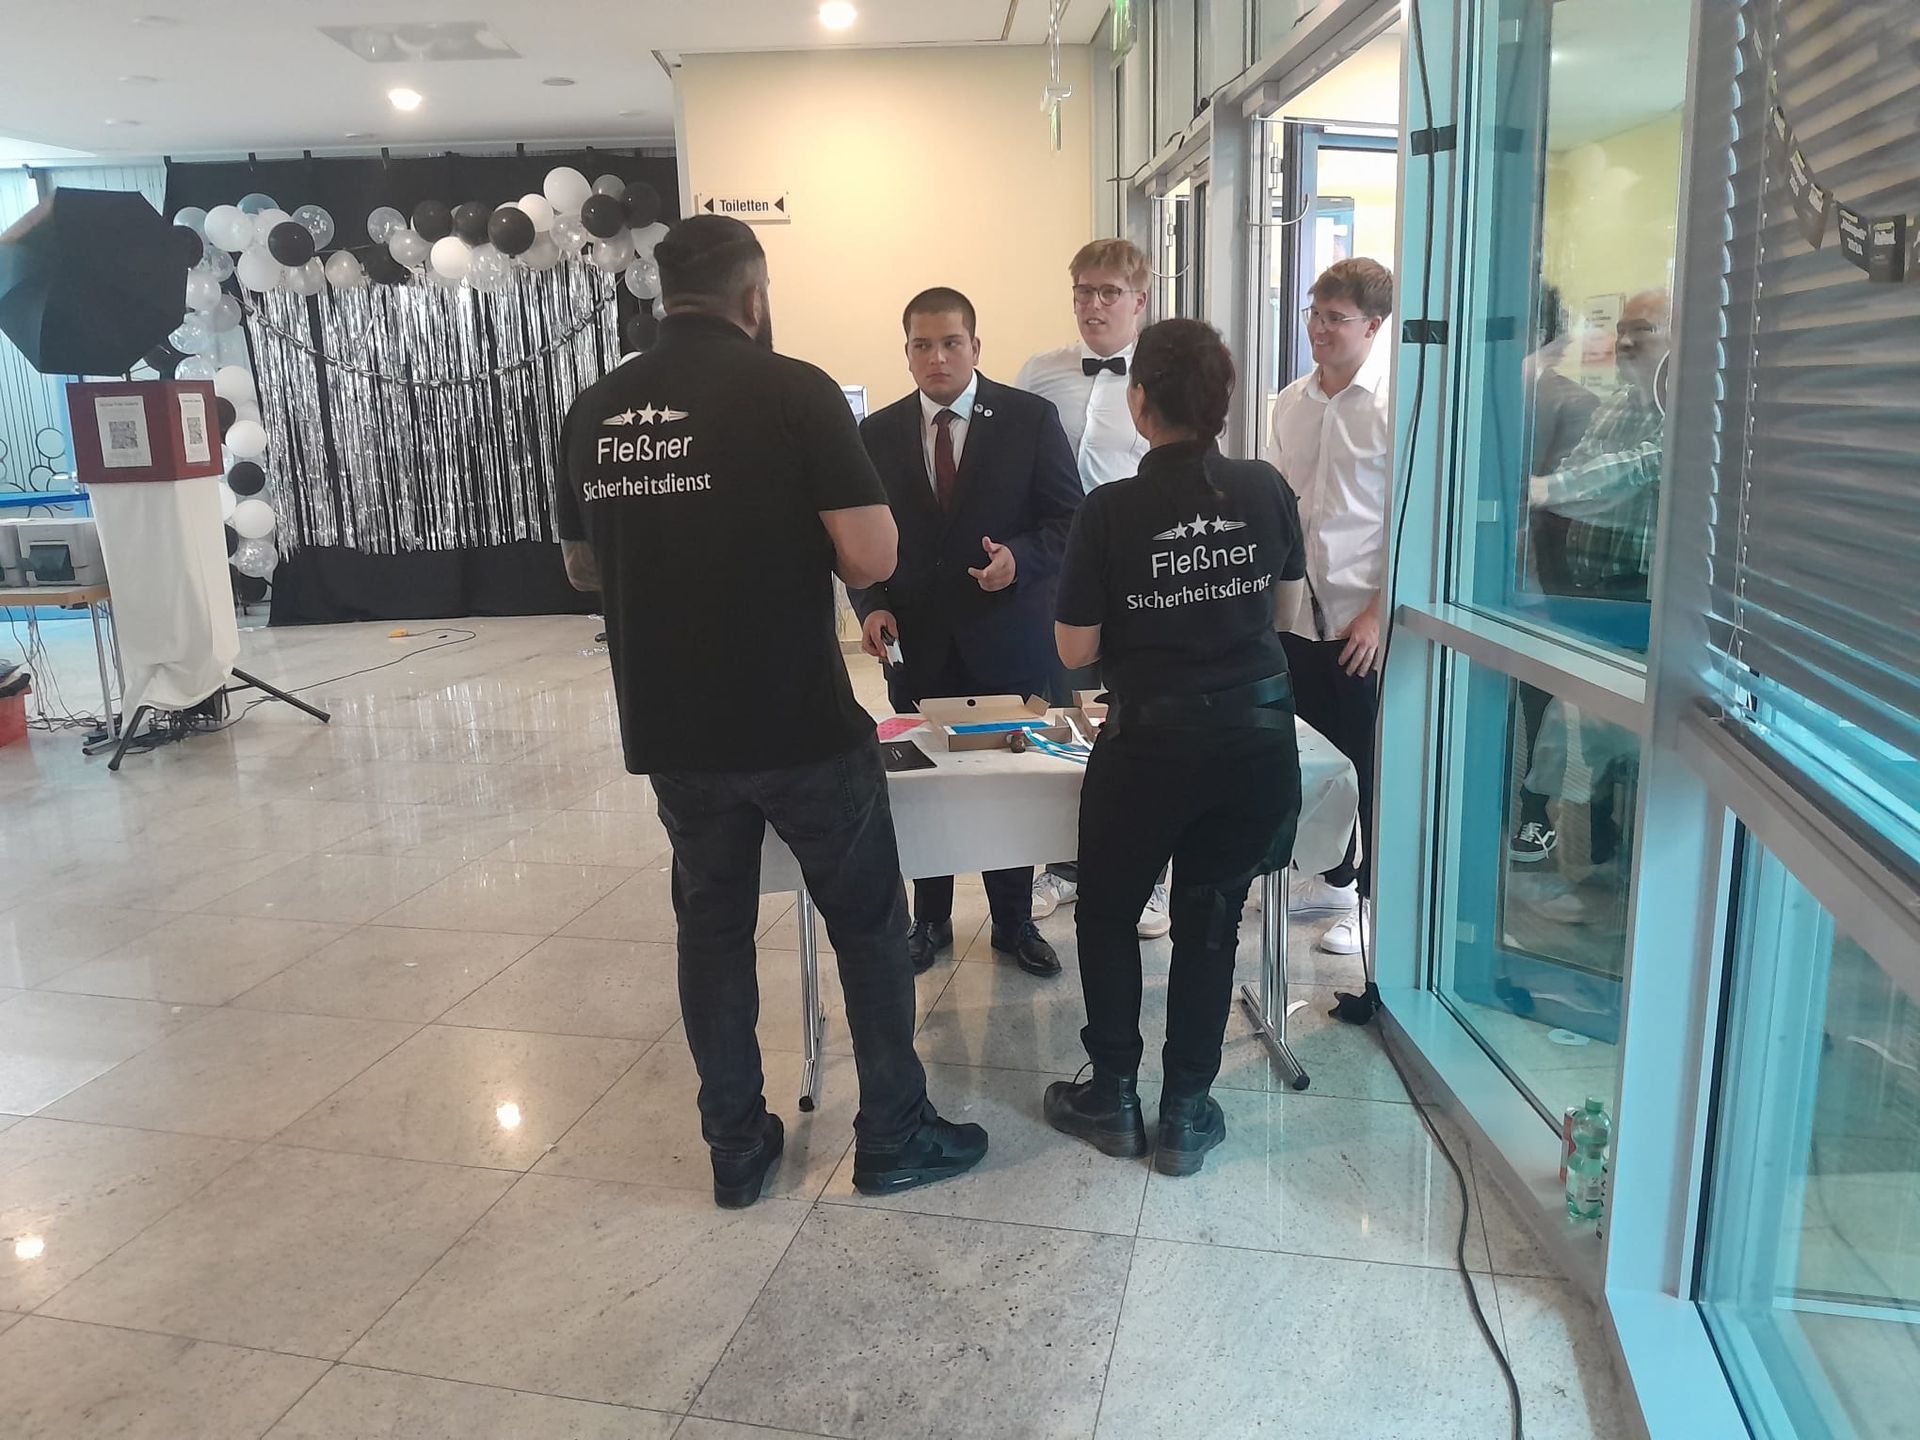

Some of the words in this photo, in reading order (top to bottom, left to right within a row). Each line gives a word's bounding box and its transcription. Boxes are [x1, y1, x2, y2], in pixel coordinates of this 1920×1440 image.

[719, 199, 769, 212] Toiletten
[597, 434, 693, 465] Fleßner
[583, 472, 711, 502] Sicherheitsdienst
[1151, 543, 1257, 578] Fleßner
[1126, 573, 1272, 610] Sicherheitsdienst
